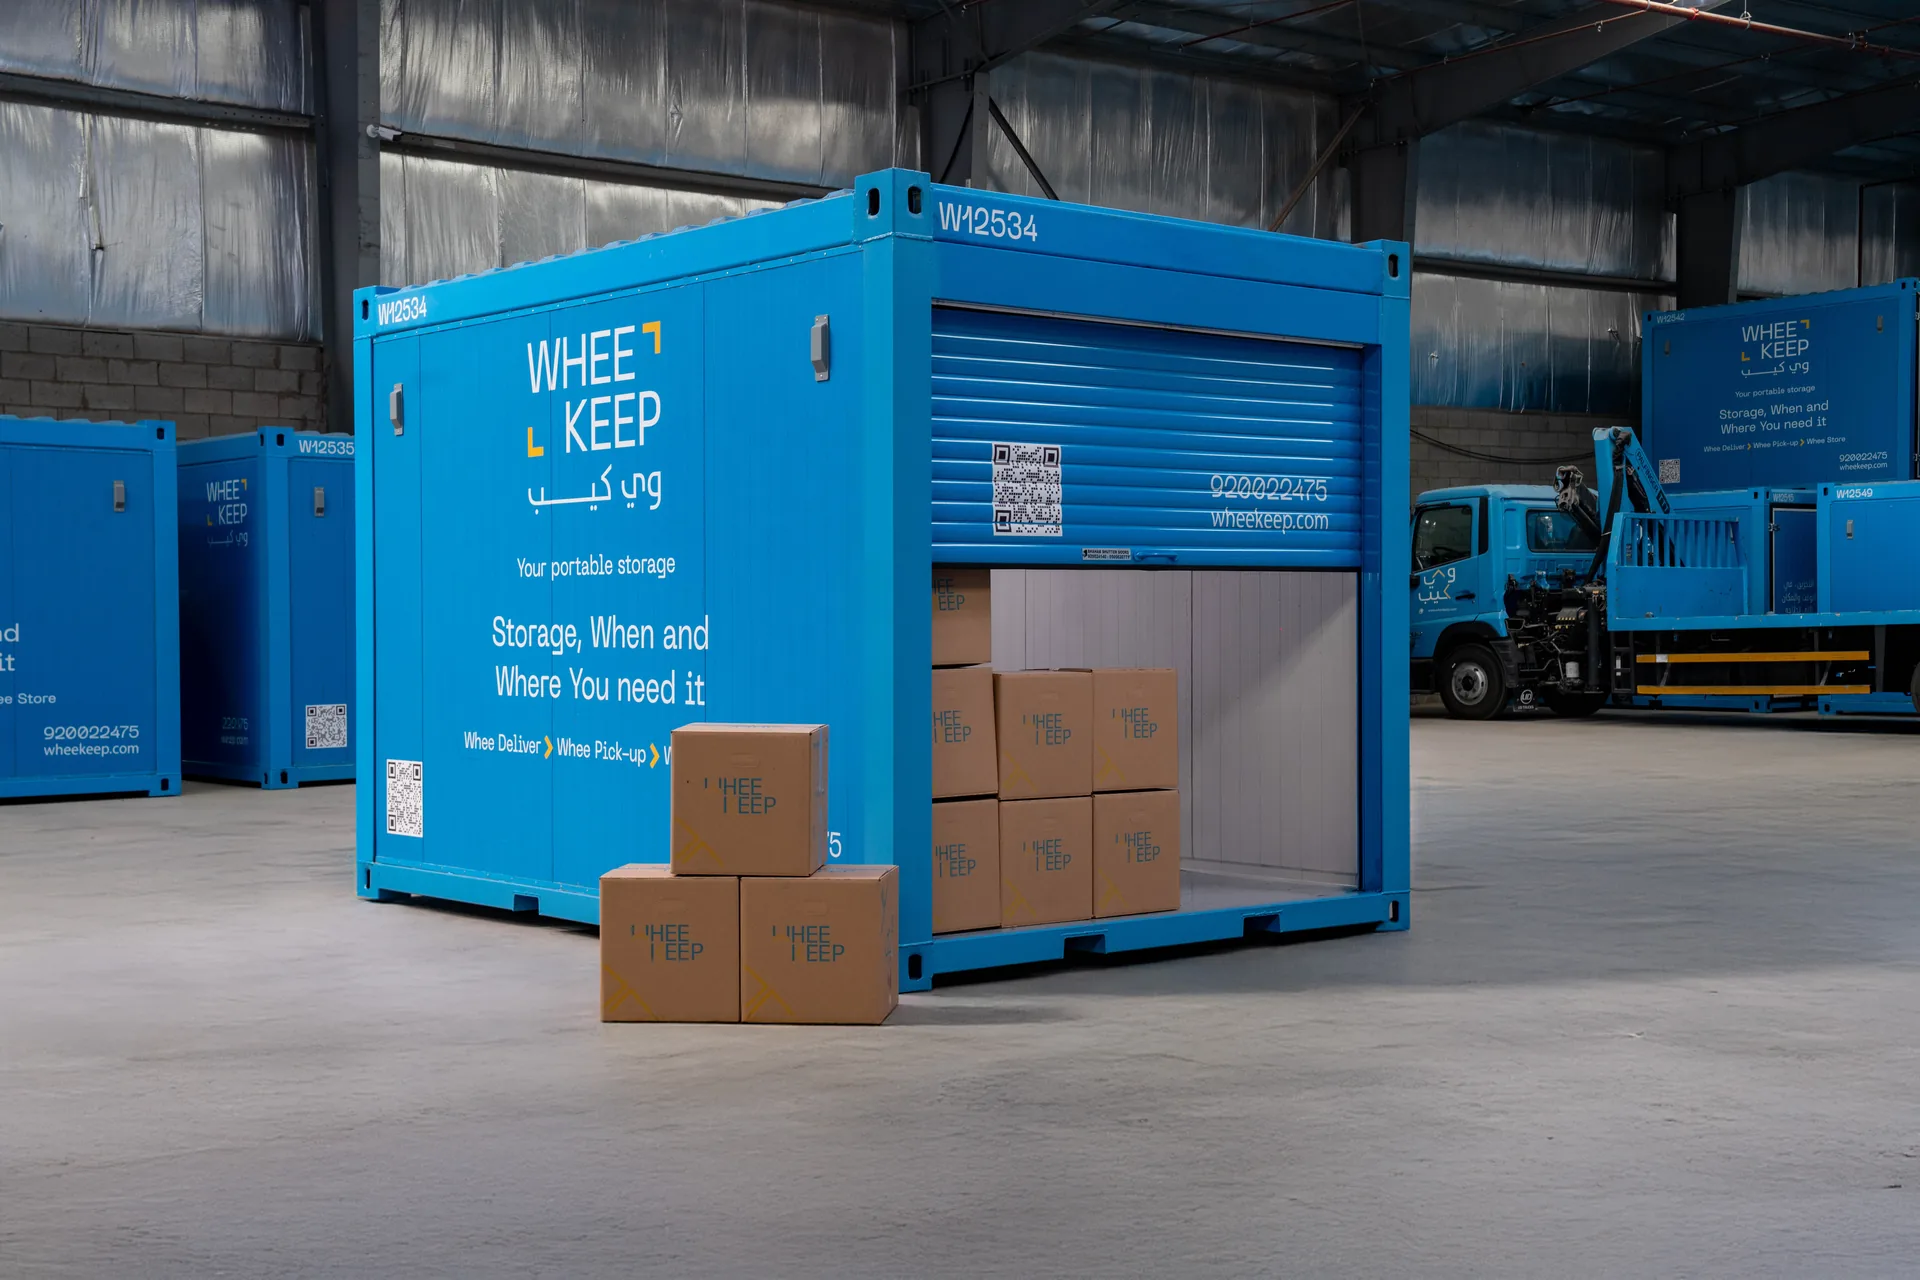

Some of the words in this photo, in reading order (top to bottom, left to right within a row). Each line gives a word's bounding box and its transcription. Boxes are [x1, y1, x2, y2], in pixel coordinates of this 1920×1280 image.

[938, 202, 1038, 242] W12534
[378, 295, 427, 325] W12534
[1656, 313, 1685, 323] W12542
[1742, 321, 1797, 342] WHEE
[527, 325, 635, 393] WHEE
[1761, 339, 1808, 359] KEEP
[1752, 386, 1785, 398] portable
[1786, 385, 1816, 394] storage
[1719, 407, 1767, 420] Storage,
[1770, 404, 1803, 415] When
[1806, 400, 1829, 412] and
[565, 391, 660, 453] KEEP
[1721, 424, 1756, 434] Where
[1760, 420, 1780, 431] You
[1784, 417, 1813, 429] need
[1816, 416, 1827, 427] it
[299, 440, 355, 454] W12535
[1722, 444, 1746, 452] Deliver
[1839, 452, 1888, 462] 920022475
[1839, 462, 1888, 471] wheekeep.com
[206, 479, 240, 502] WHEE
[527, 464, 612, 515] كيب
[621, 471, 662, 511] وي
[1210, 474, 1328, 502] 920022475
[1836, 488, 1873, 499] W12549
[218, 503, 248, 526] KEEP
[1210, 506, 1329, 535] wheekeep.com
[517, 559, 547, 578] Your
[551, 555, 614, 581] portable
[617, 554, 676, 579] storage
[938, 594, 965, 611] EEP
[491, 614, 583, 656] Storage,
[589, 614, 655, 650] When
[662, 615, 709, 651] and
[495, 664, 562, 699] Where
[568, 667, 610, 702] You
[617, 670, 676, 704] need
[684, 671, 706, 706] it
[17, 692, 57, 704] Store
[933, 711, 961, 727] HEE
[43, 725, 140, 740] 920022475
[43, 743, 140, 757] wheekeep.com
[464, 731, 495, 750] Whee
[498, 734, 542, 755] Deliver
[556, 738, 591, 758] Whee
[594, 740, 647, 766] Pick-up
[935, 843, 967, 861] HEE
